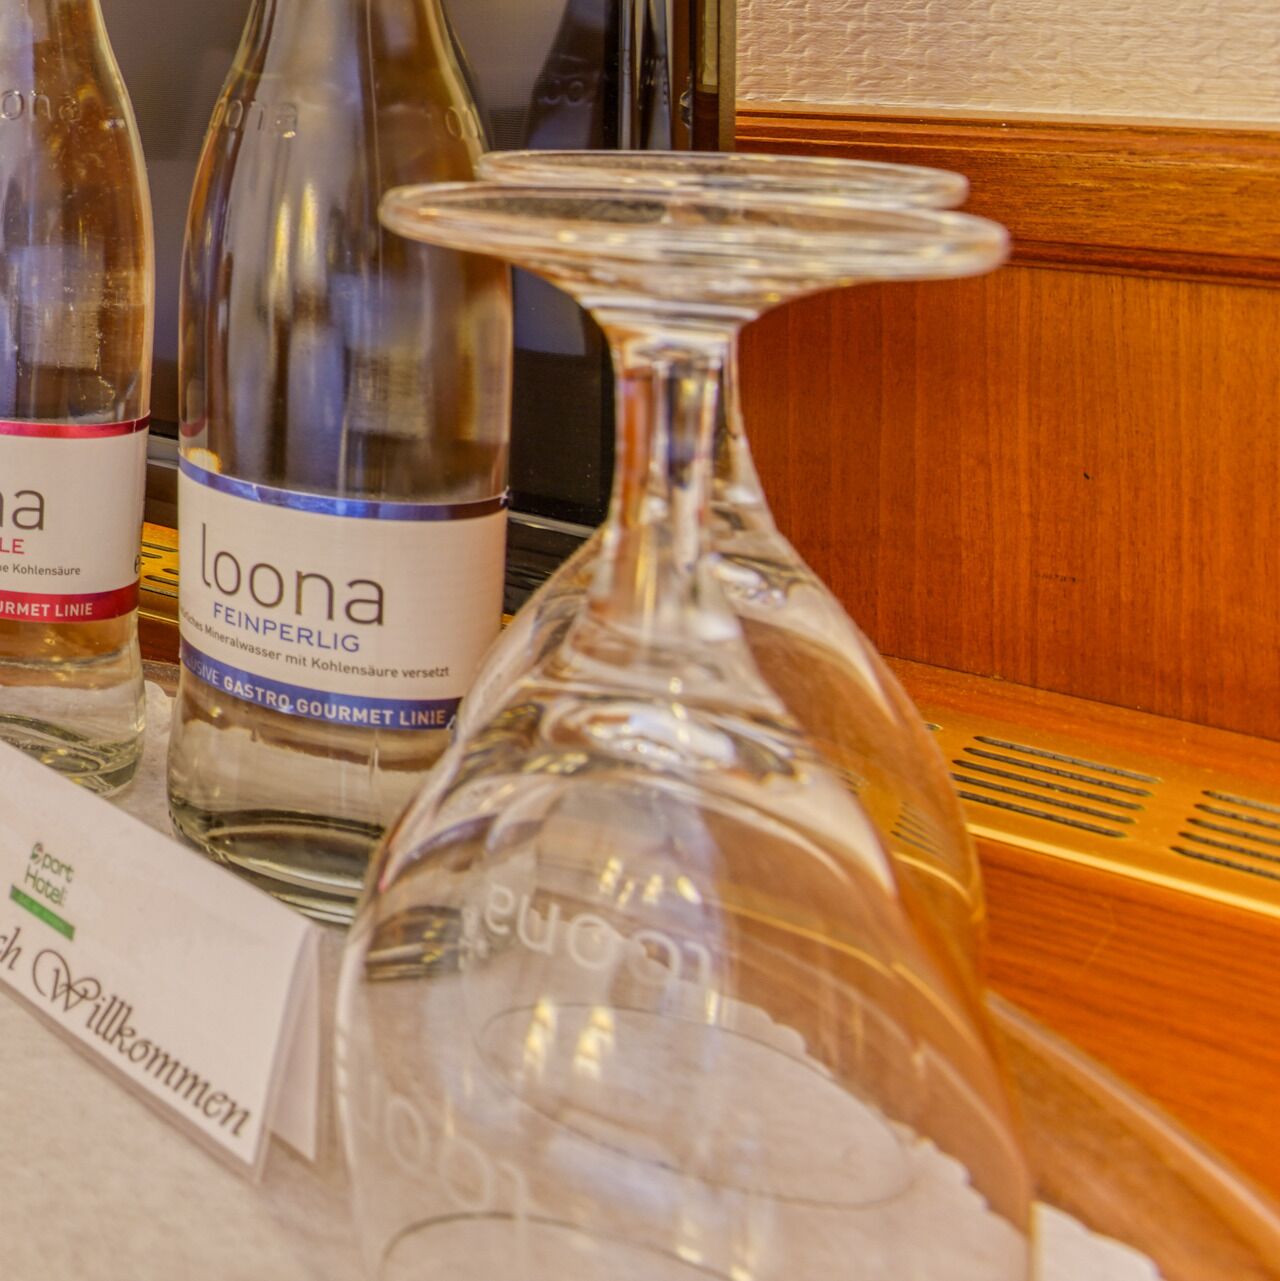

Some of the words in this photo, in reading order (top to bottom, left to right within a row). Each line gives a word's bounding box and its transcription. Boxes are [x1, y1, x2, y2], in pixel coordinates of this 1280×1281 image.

[12, 562, 81, 577] Kohlensäure
[200, 522, 385, 627] loona
[54, 602, 94, 618] LINIE
[212, 601, 361, 654] FEINPERLIG
[203, 624, 283, 662] Mineralwasser
[285, 652, 307, 668] mit
[311, 655, 399, 680] Kohlensäure
[401, 664, 450, 679] versetzt
[223, 675, 292, 710] GASTRO
[295, 695, 395, 726] GOURMET
[399, 708, 447, 728] LINIE
[23, 863, 65, 907] Hotel
[30, 841, 75, 883] Sport
[31, 947, 253, 1138] Willkommen
